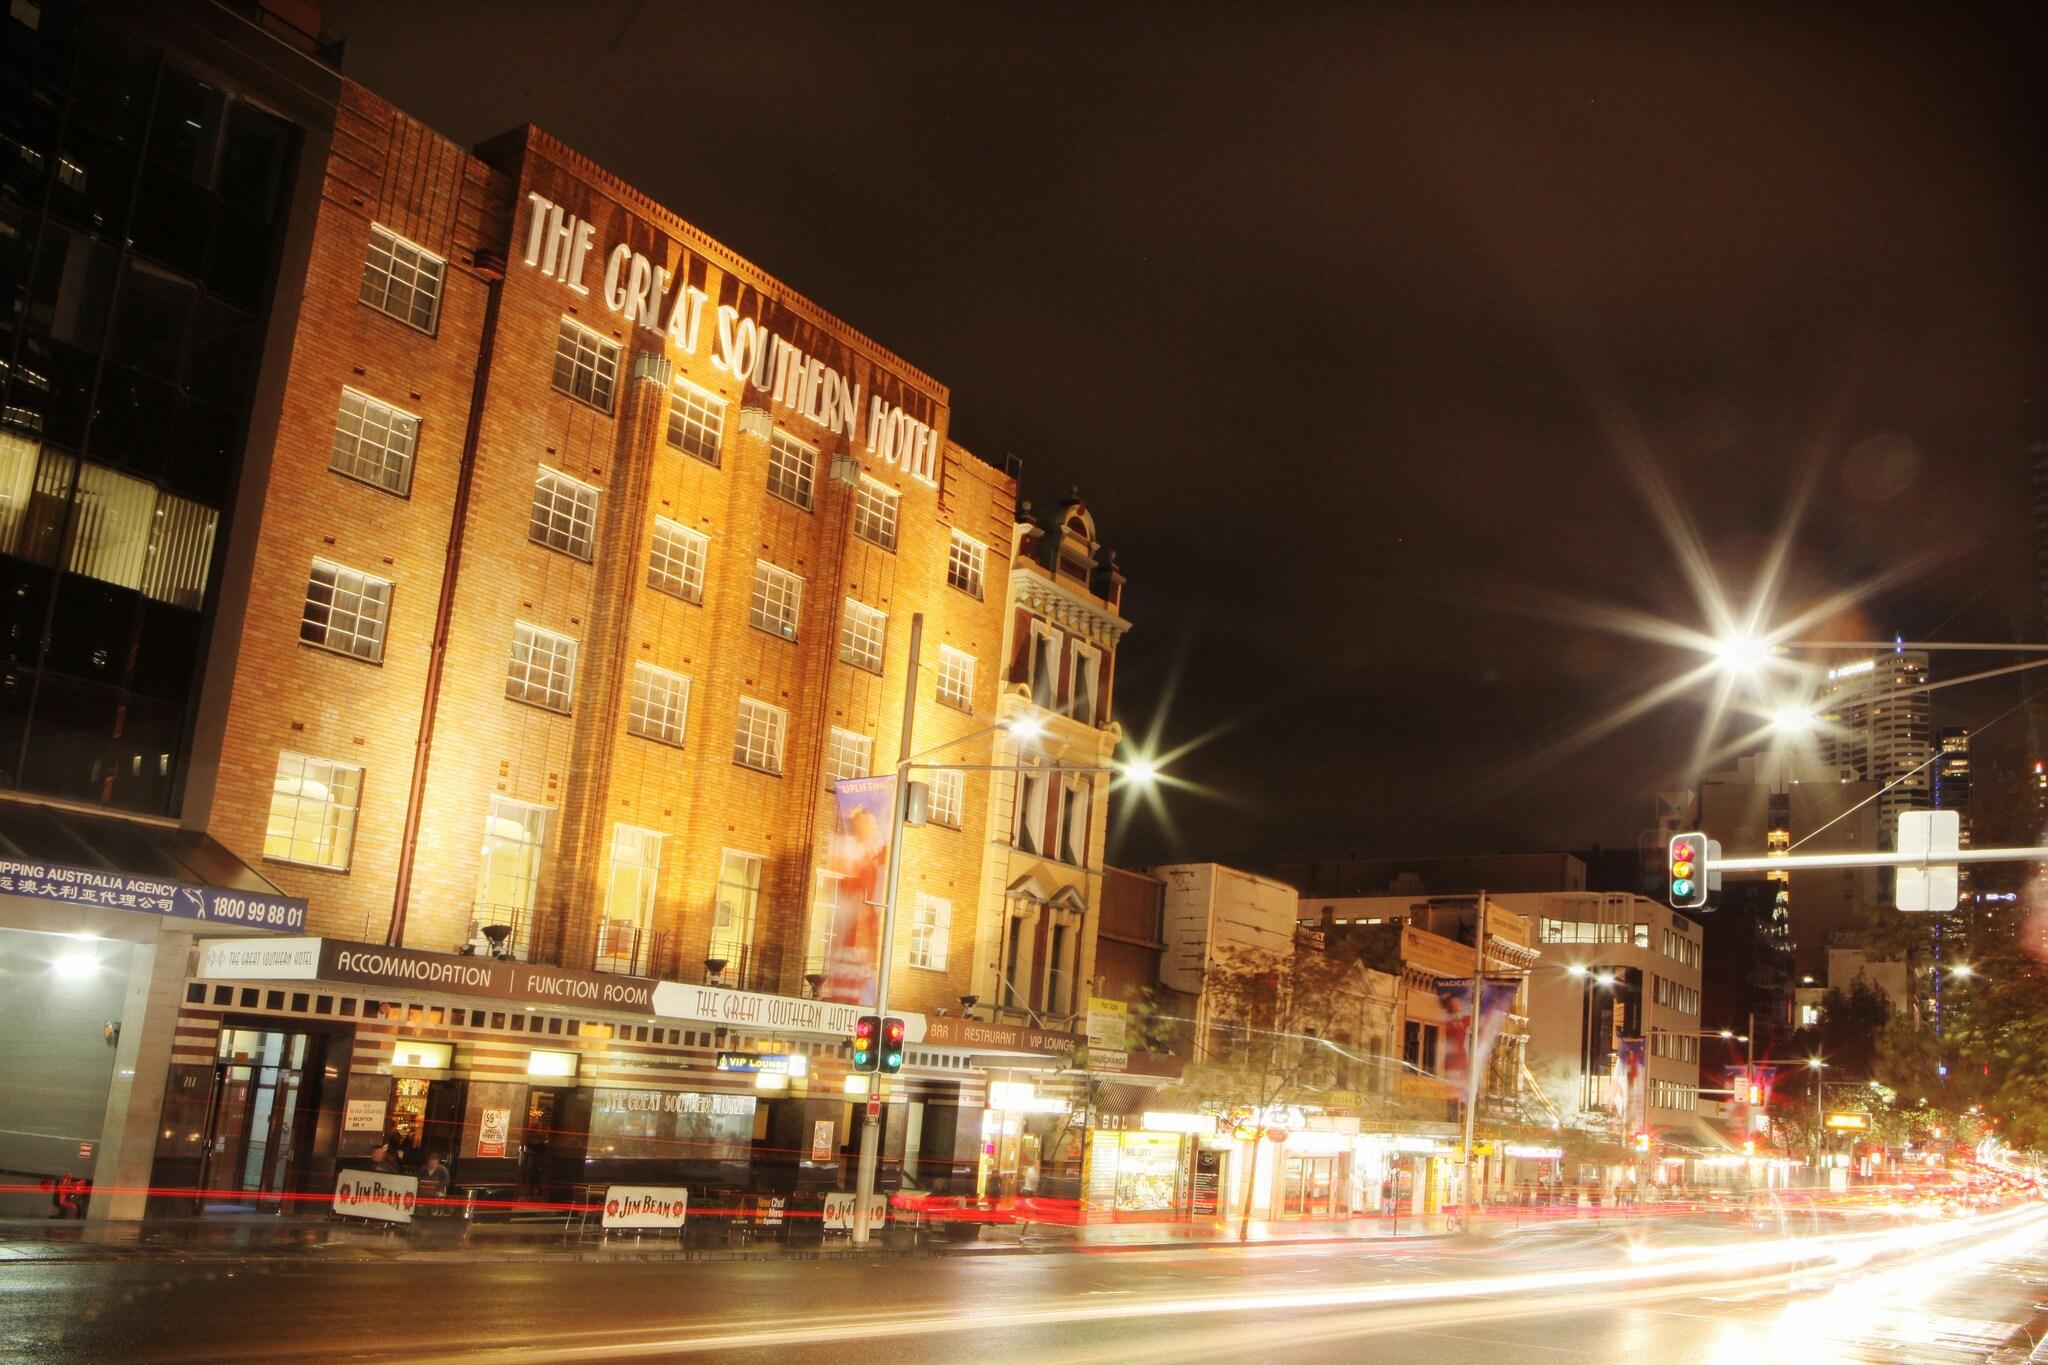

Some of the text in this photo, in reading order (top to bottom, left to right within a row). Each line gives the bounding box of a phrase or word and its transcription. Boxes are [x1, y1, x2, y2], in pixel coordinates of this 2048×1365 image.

[525, 191, 938, 488] THE GREAT SOUTHERN HOTEL
[47, 868, 123, 889] AUSTRALIA
[126, 881, 178, 898] AGENCY
[213, 896, 303, 927] 1800 99 88 01
[229, 951, 313, 966] THE GREAT SOUTHERN HOTEL
[337, 951, 648, 1005] ACCOMMODATION FUNCTION ROOM
[696, 990, 859, 1032] THE GREAT SOUTHERN HOTEL
[930, 1023, 1075, 1051] BAR RESTAURANT VIP LOUNGE
[729, 1057, 789, 1070] VIP LOUNGE
[627, 1093, 662, 1111] GREAT
[1102, 1114, 1127, 1130] SOL
[351, 1181, 401, 1210] JIM BEAM
[620, 1195, 671, 1218] JIM BEAM
